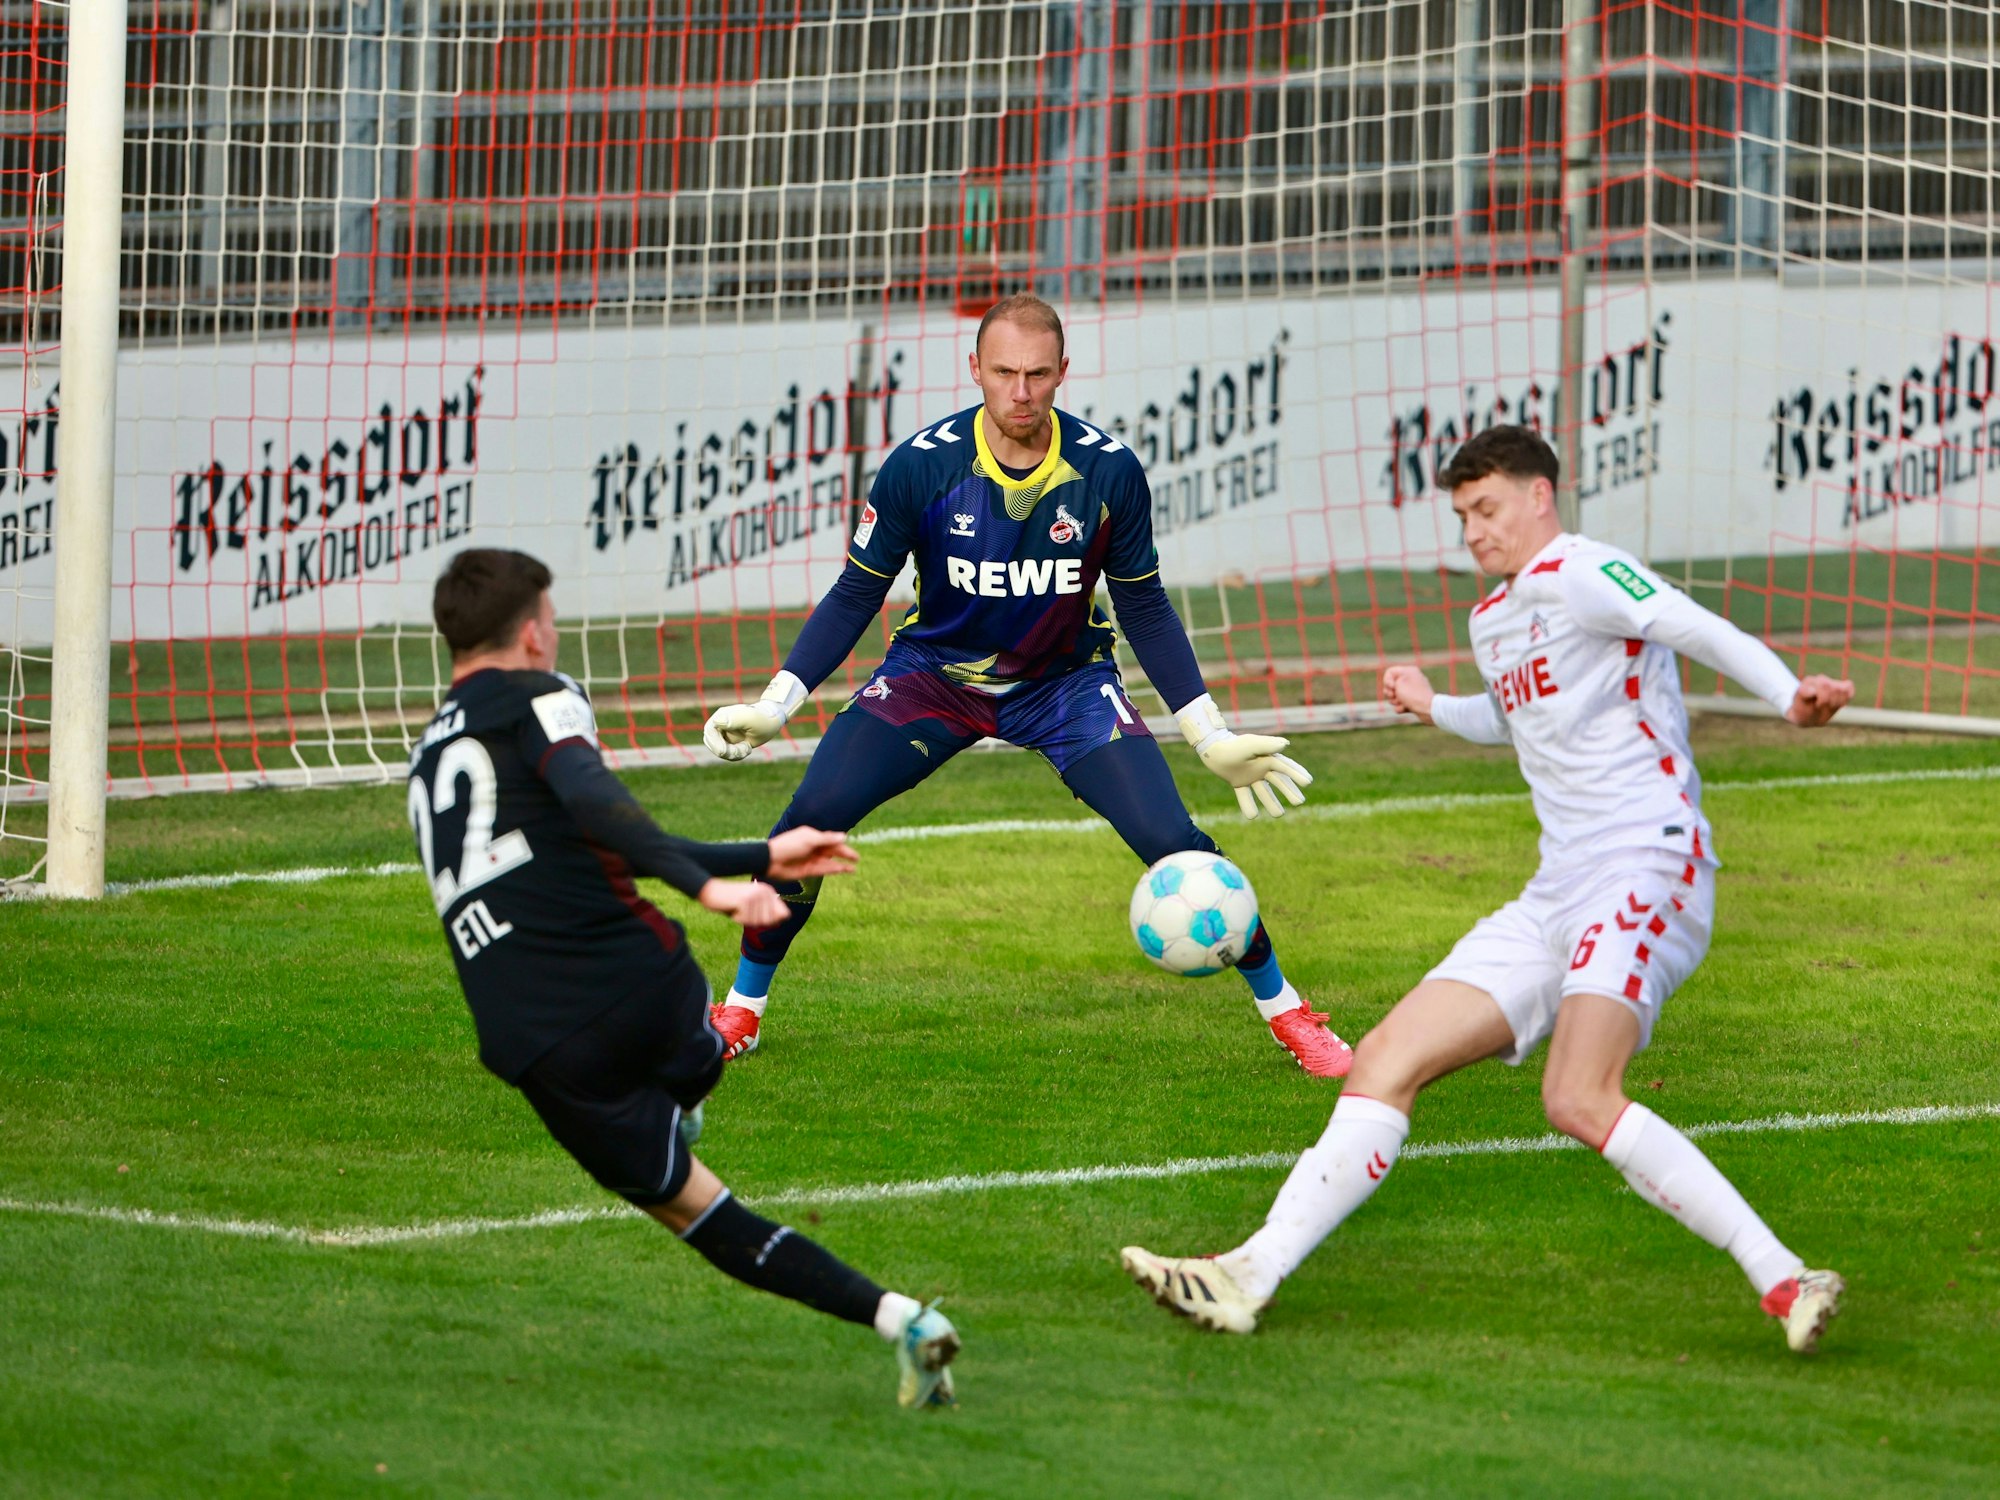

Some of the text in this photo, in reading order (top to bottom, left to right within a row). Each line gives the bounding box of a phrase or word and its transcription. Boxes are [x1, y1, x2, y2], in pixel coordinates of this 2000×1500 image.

[171, 365, 486, 572] Reissdorf
[253, 480, 472, 610] ALKOHOLFREI
[946, 555, 1083, 598] REWE
[1100, 683, 1135, 725] 1
[408, 736, 534, 917] 22
[451, 899, 514, 961] ETL
[1570, 923, 1604, 970] 6
